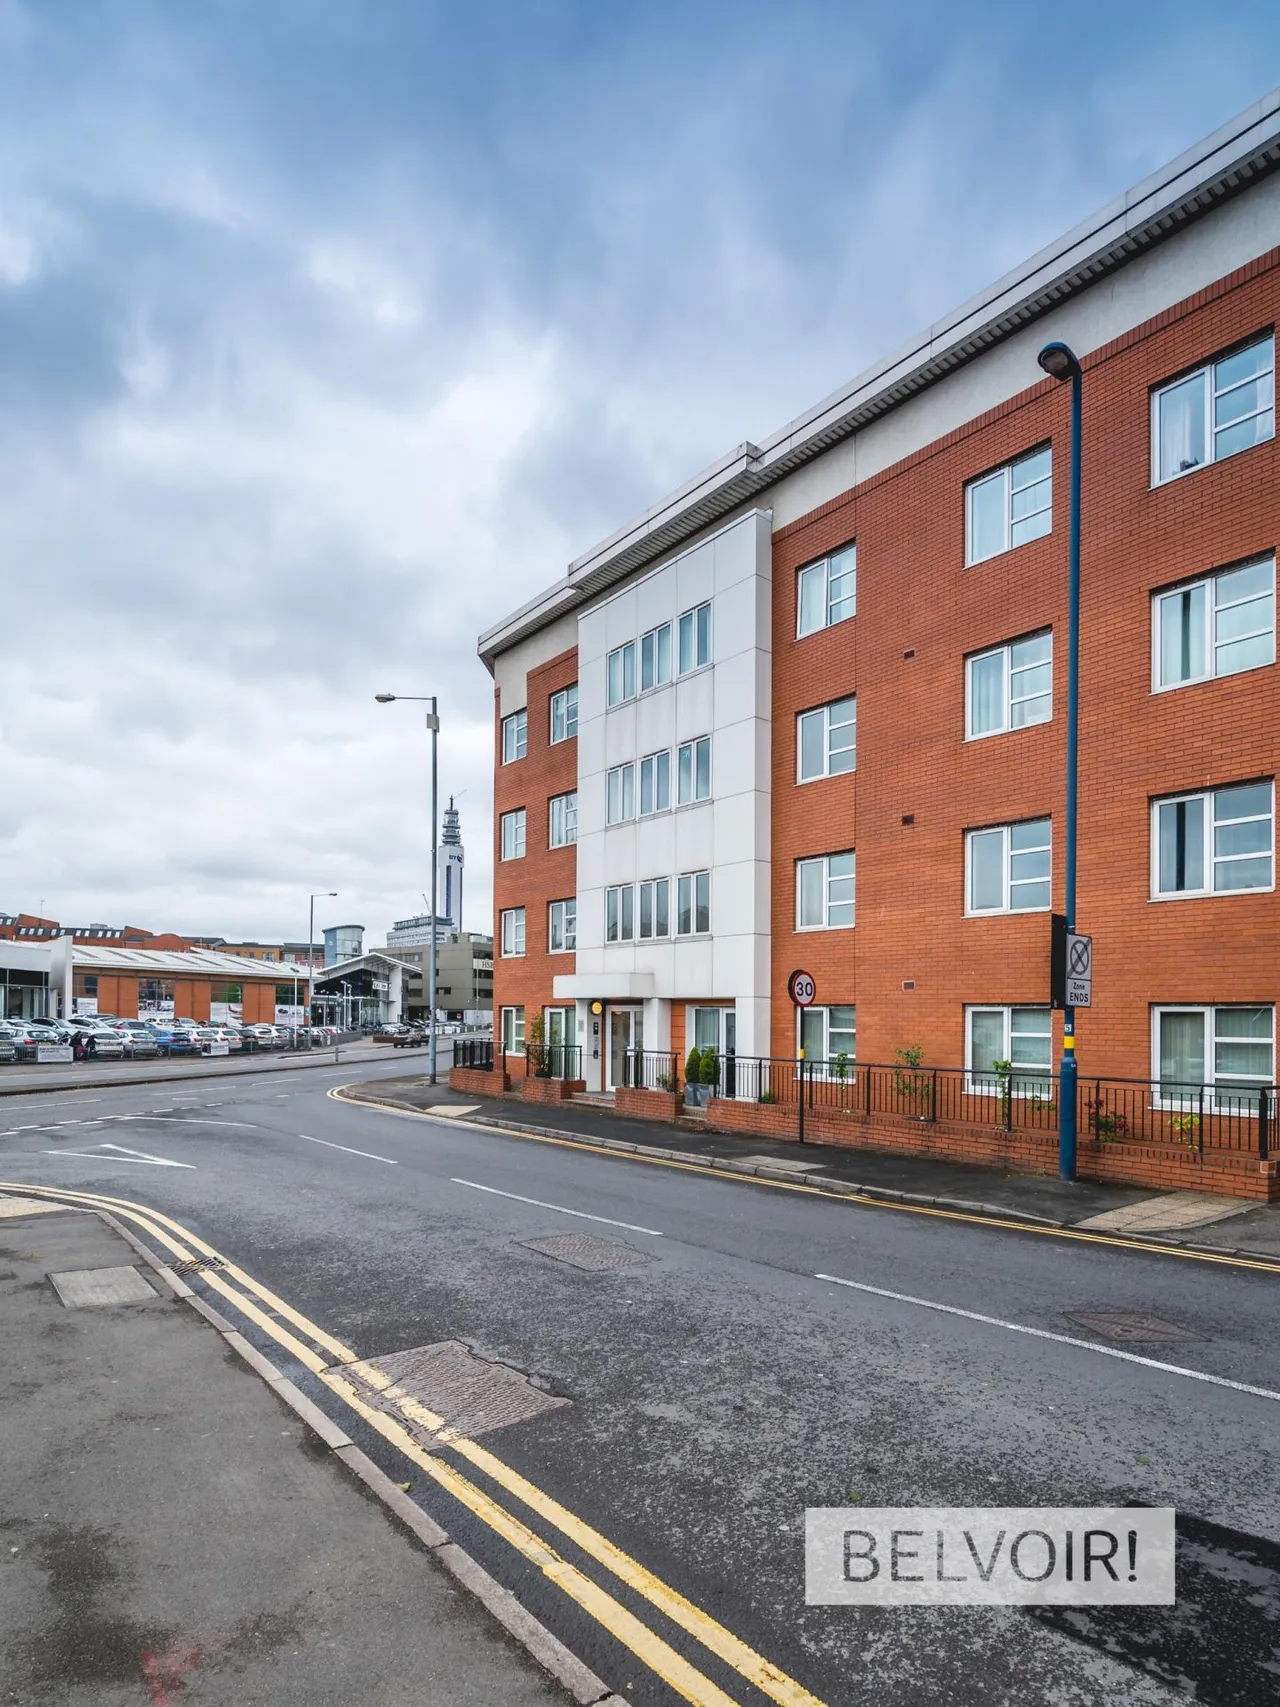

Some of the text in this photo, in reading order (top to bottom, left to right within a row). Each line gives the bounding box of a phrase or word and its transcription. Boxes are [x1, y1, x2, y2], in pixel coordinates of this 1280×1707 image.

[797, 982, 813, 996] 30
[1073, 982, 1085, 990] Zone
[1070, 992, 1089, 1002] ENDS
